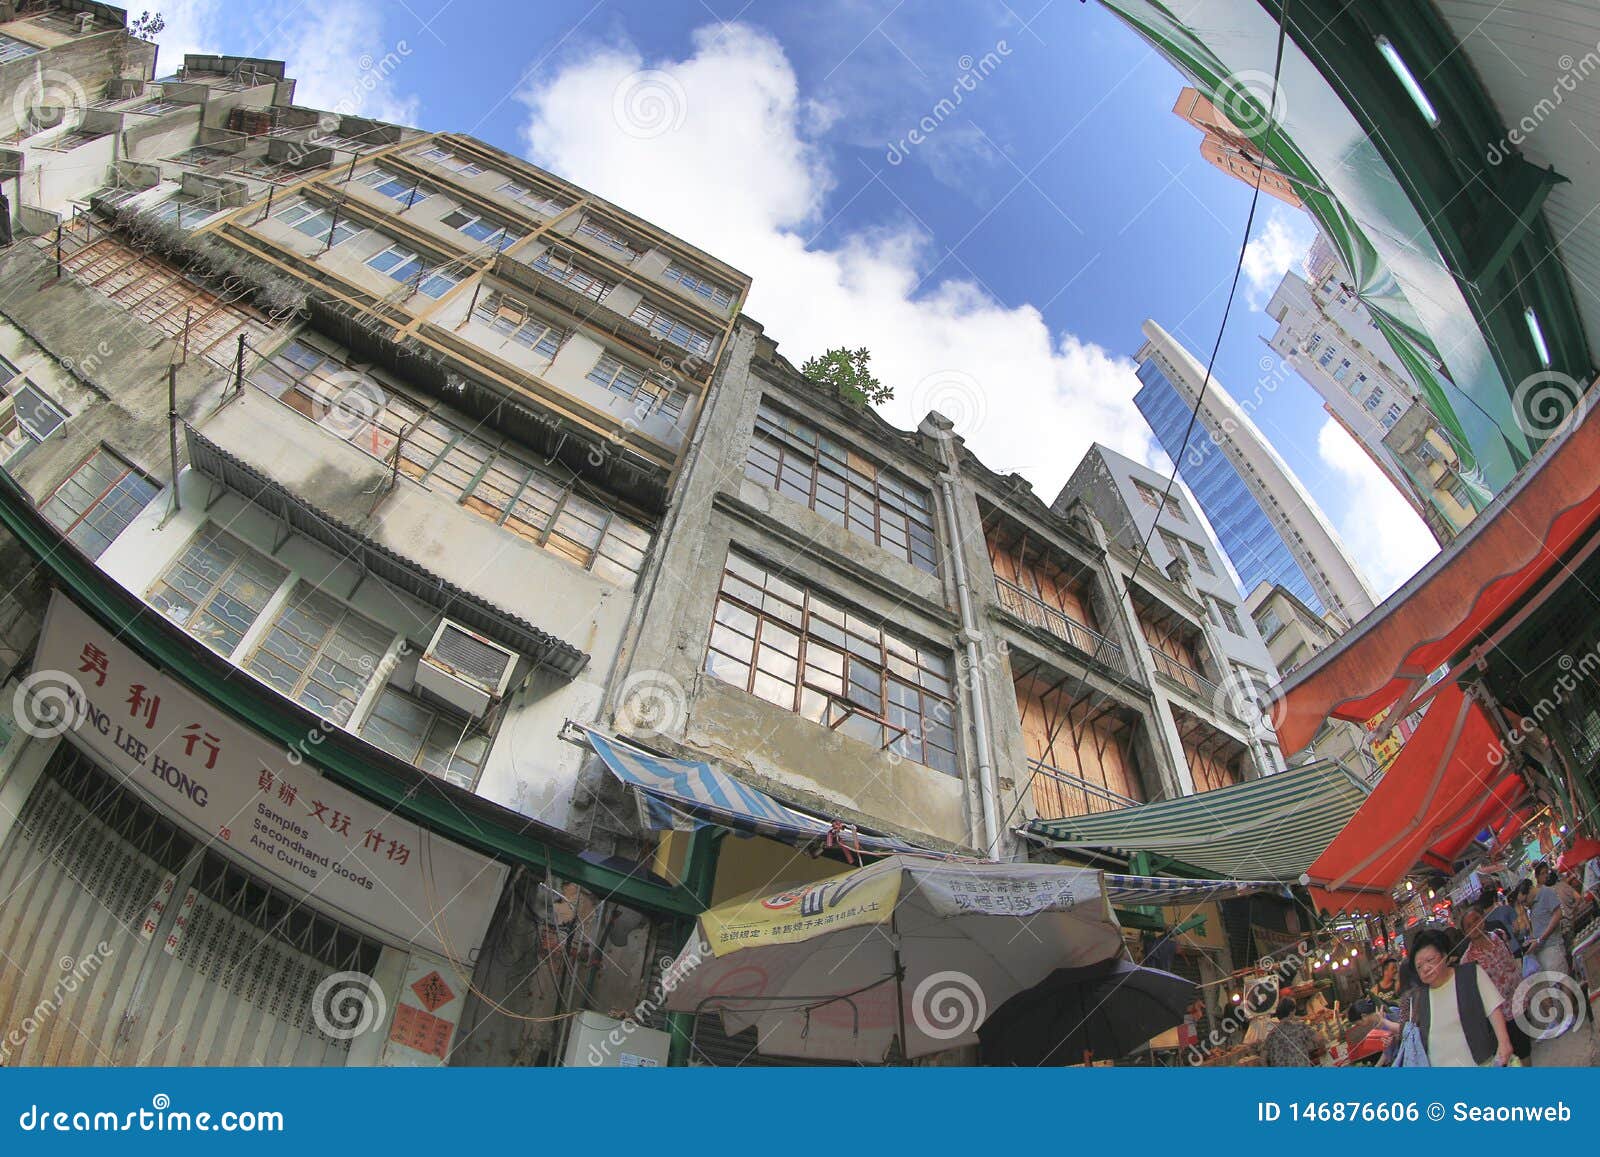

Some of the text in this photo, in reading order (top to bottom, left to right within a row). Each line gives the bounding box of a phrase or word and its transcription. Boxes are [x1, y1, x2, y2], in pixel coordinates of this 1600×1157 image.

[79, 642, 221, 769] 勇利行
[113, 726, 149, 766] LEE
[151, 754, 208, 808] HONG
[257, 802, 310, 840] Samples
[363, 828, 410, 865] 什物
[250, 834, 318, 879] And Curios
[253, 818, 374, 891] Secondhand Goods
